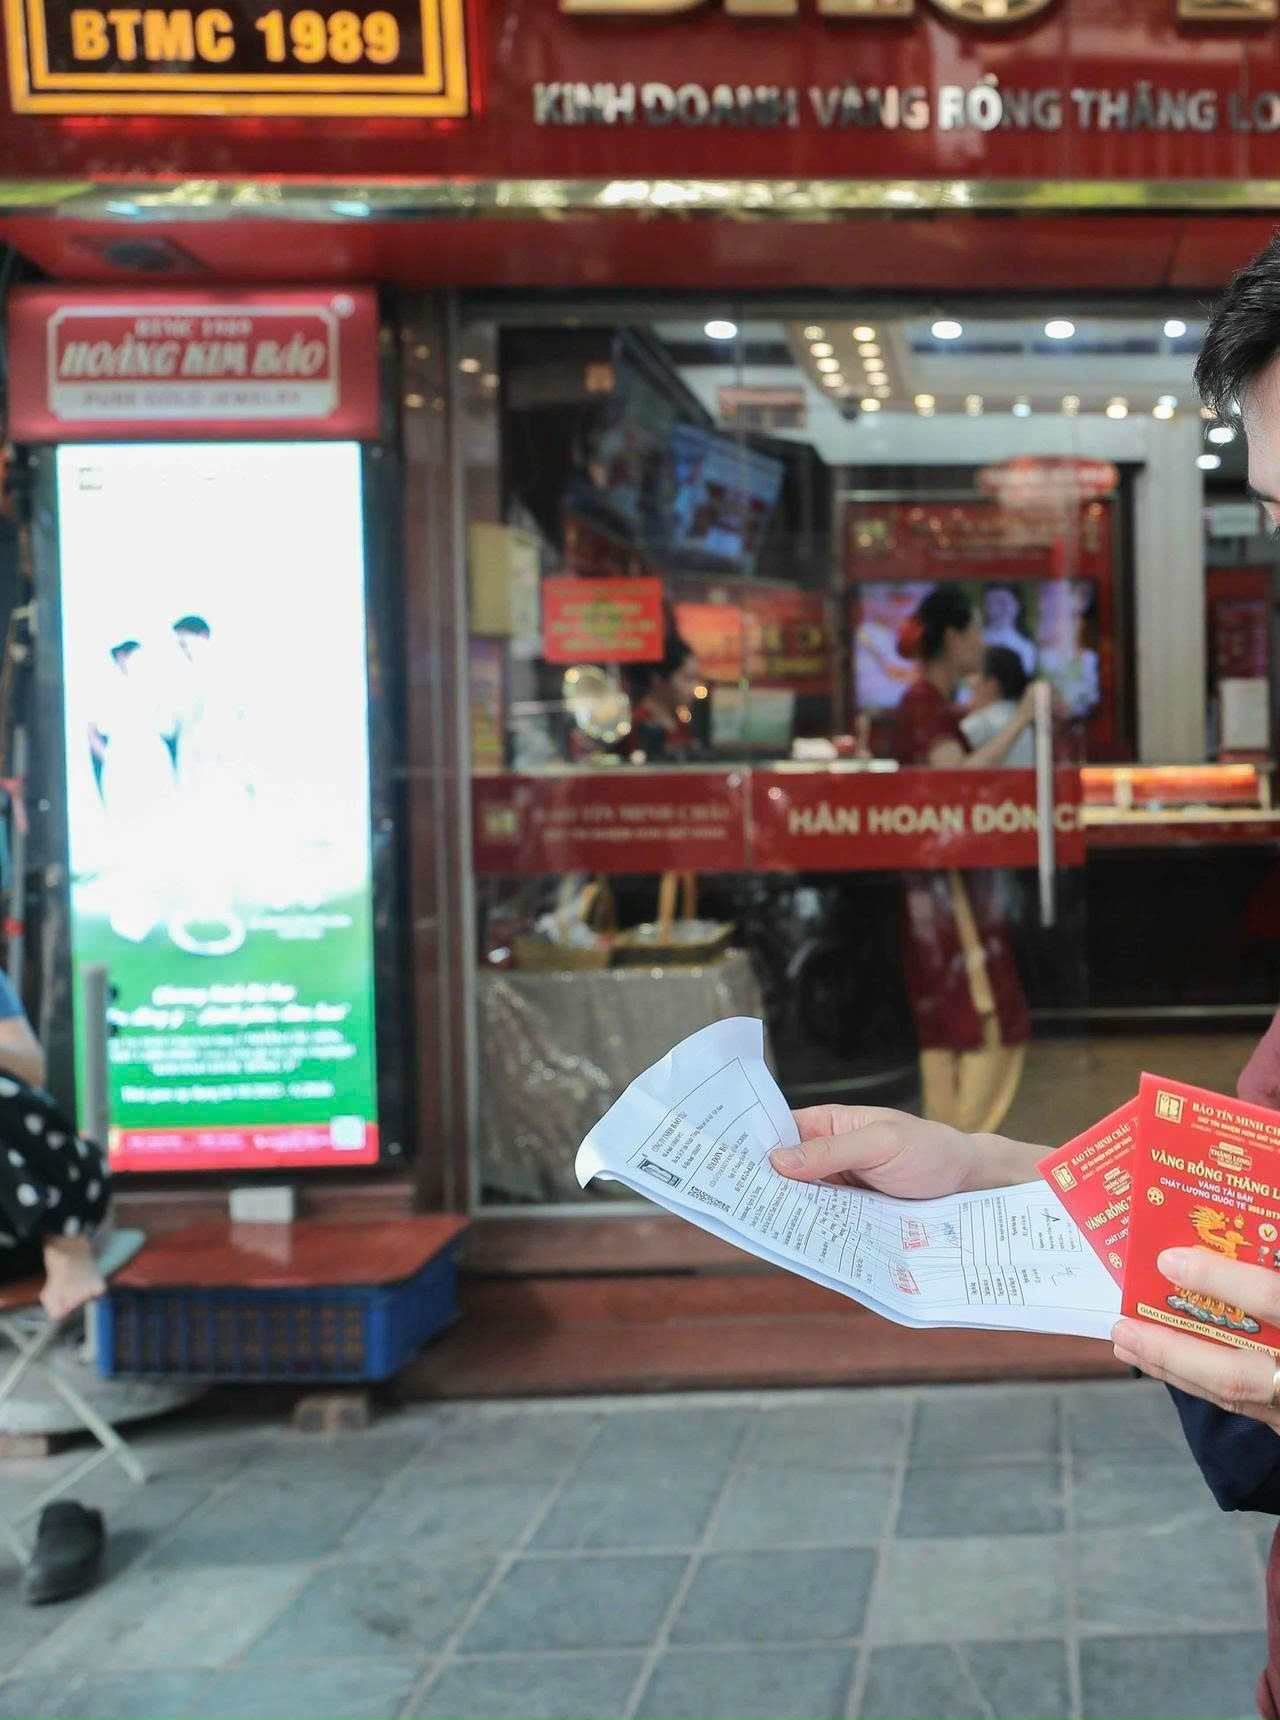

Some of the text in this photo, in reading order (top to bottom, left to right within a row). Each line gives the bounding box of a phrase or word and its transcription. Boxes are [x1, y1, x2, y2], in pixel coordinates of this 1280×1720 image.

[70, 11, 400, 63] BTMC 1989
[533, 82, 635, 126] KINH
[641, 82, 798, 127] DOANH
[809, 77, 930, 129] VÀNG
[180, 341, 248, 376] KIM
[868, 804, 964, 834] HOAN
[1235, 1116, 1263, 1131] MINH
[1152, 1149, 1184, 1169] VÀNG
[1187, 1161, 1223, 1181] RỒNG
[1226, 1174, 1269, 1195] THĂNG
[1198, 1180, 1220, 1193] VÀNG
[1085, 1200, 1129, 1230] VÀNG RỒNG
[1140, 1307, 1158, 1317] GIAO
[1160, 1314, 1178, 1323] DỊCH
